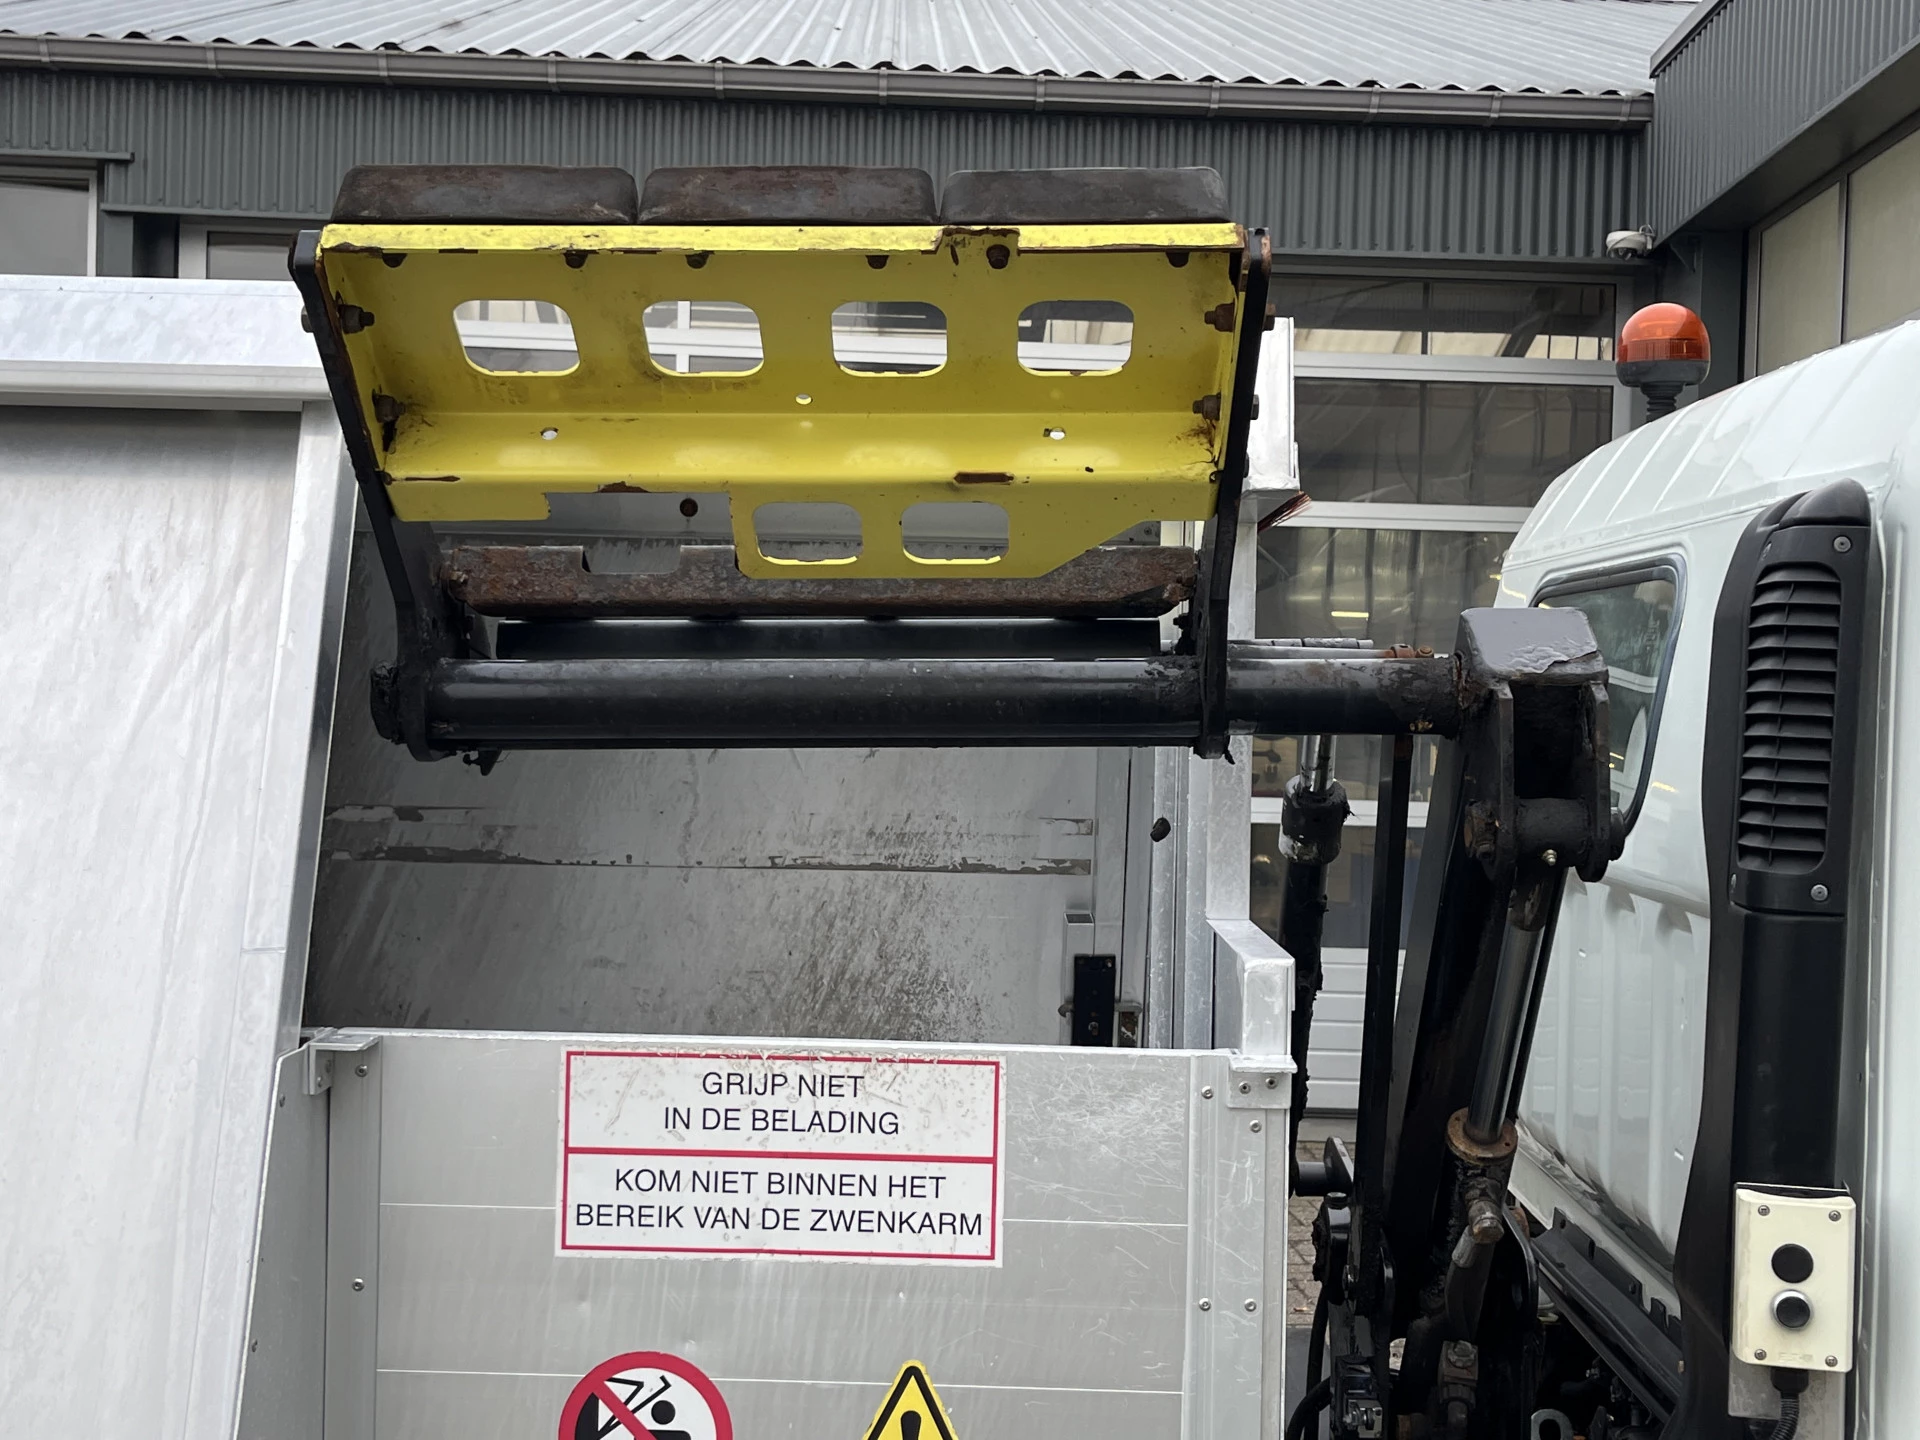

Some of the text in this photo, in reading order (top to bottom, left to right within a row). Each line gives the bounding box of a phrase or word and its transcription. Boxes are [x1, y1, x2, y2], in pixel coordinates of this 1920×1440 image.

[702, 1071, 865, 1098] GRIJP NIET
[664, 1106, 899, 1135] IN DE BELADING
[615, 1168, 947, 1199] KOM NIET BINNEN HET
[576, 1203, 982, 1236] BEREIK VAN DE ZWENKARM
